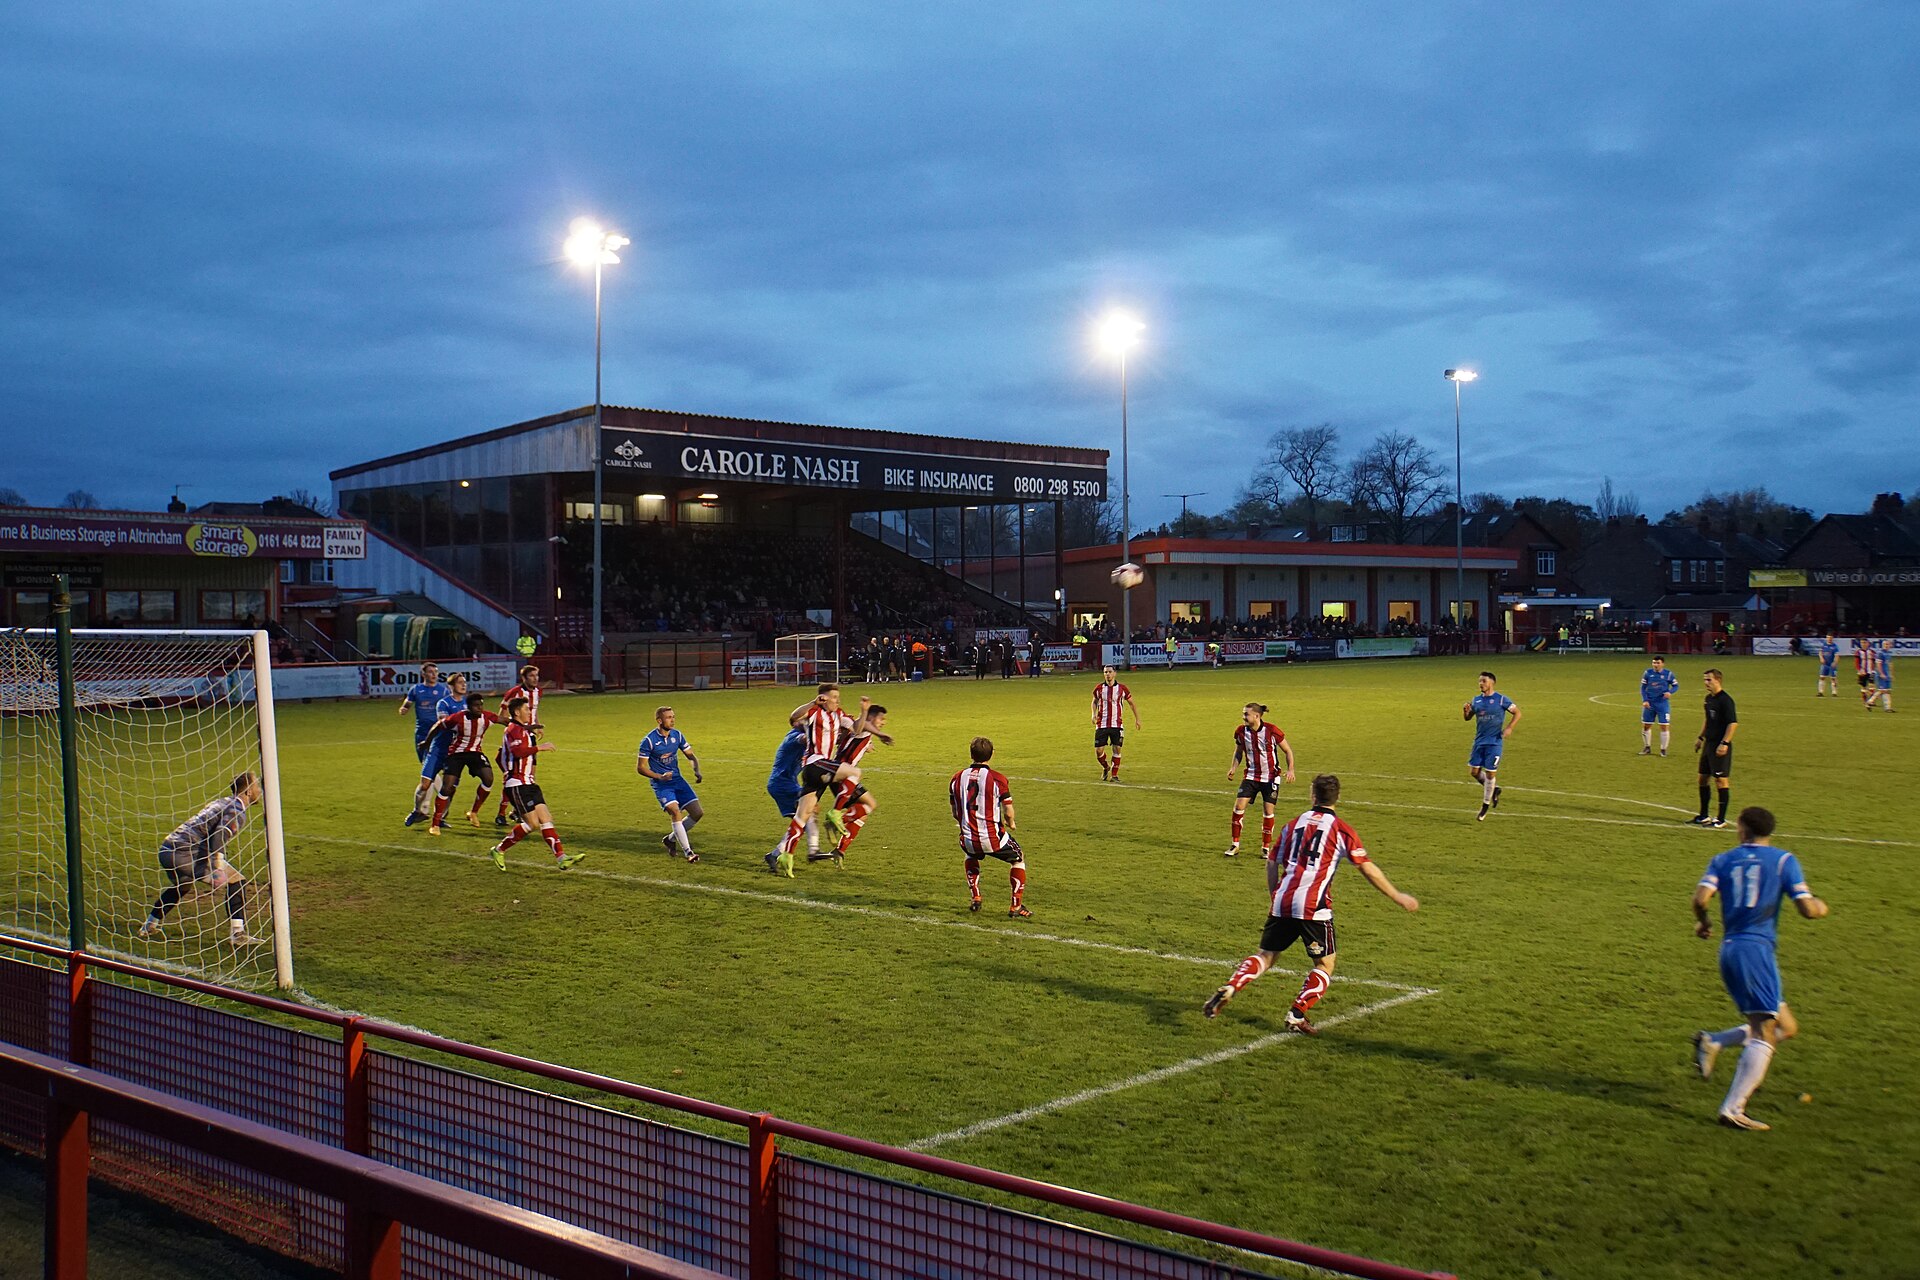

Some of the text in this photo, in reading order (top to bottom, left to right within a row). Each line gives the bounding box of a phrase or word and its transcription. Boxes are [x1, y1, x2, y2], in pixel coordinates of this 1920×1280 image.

[605, 459, 652, 469] CAROLE NASH
[680, 446, 860, 483] CAROLE NASH
[884, 468, 994, 491] BIKE INSURANCE
[1014, 476, 1100, 497] 0800 298 5500
[20, 524, 29, 539] &
[31, 525, 76, 541] Business
[78, 526, 116, 546] Storage
[118, 528, 127, 542] in
[129, 528, 182, 545] Altrincham
[202, 525, 243, 541] smart
[258, 534, 321, 549] 0161 464 8222
[326, 530, 362, 540] FAMILY
[195, 538, 248, 556] storage
[327, 545, 361, 555] STAND
[966, 781, 979, 811] 2
[1292, 826, 1324, 867] 14
[1730, 865, 1761, 908] 11
